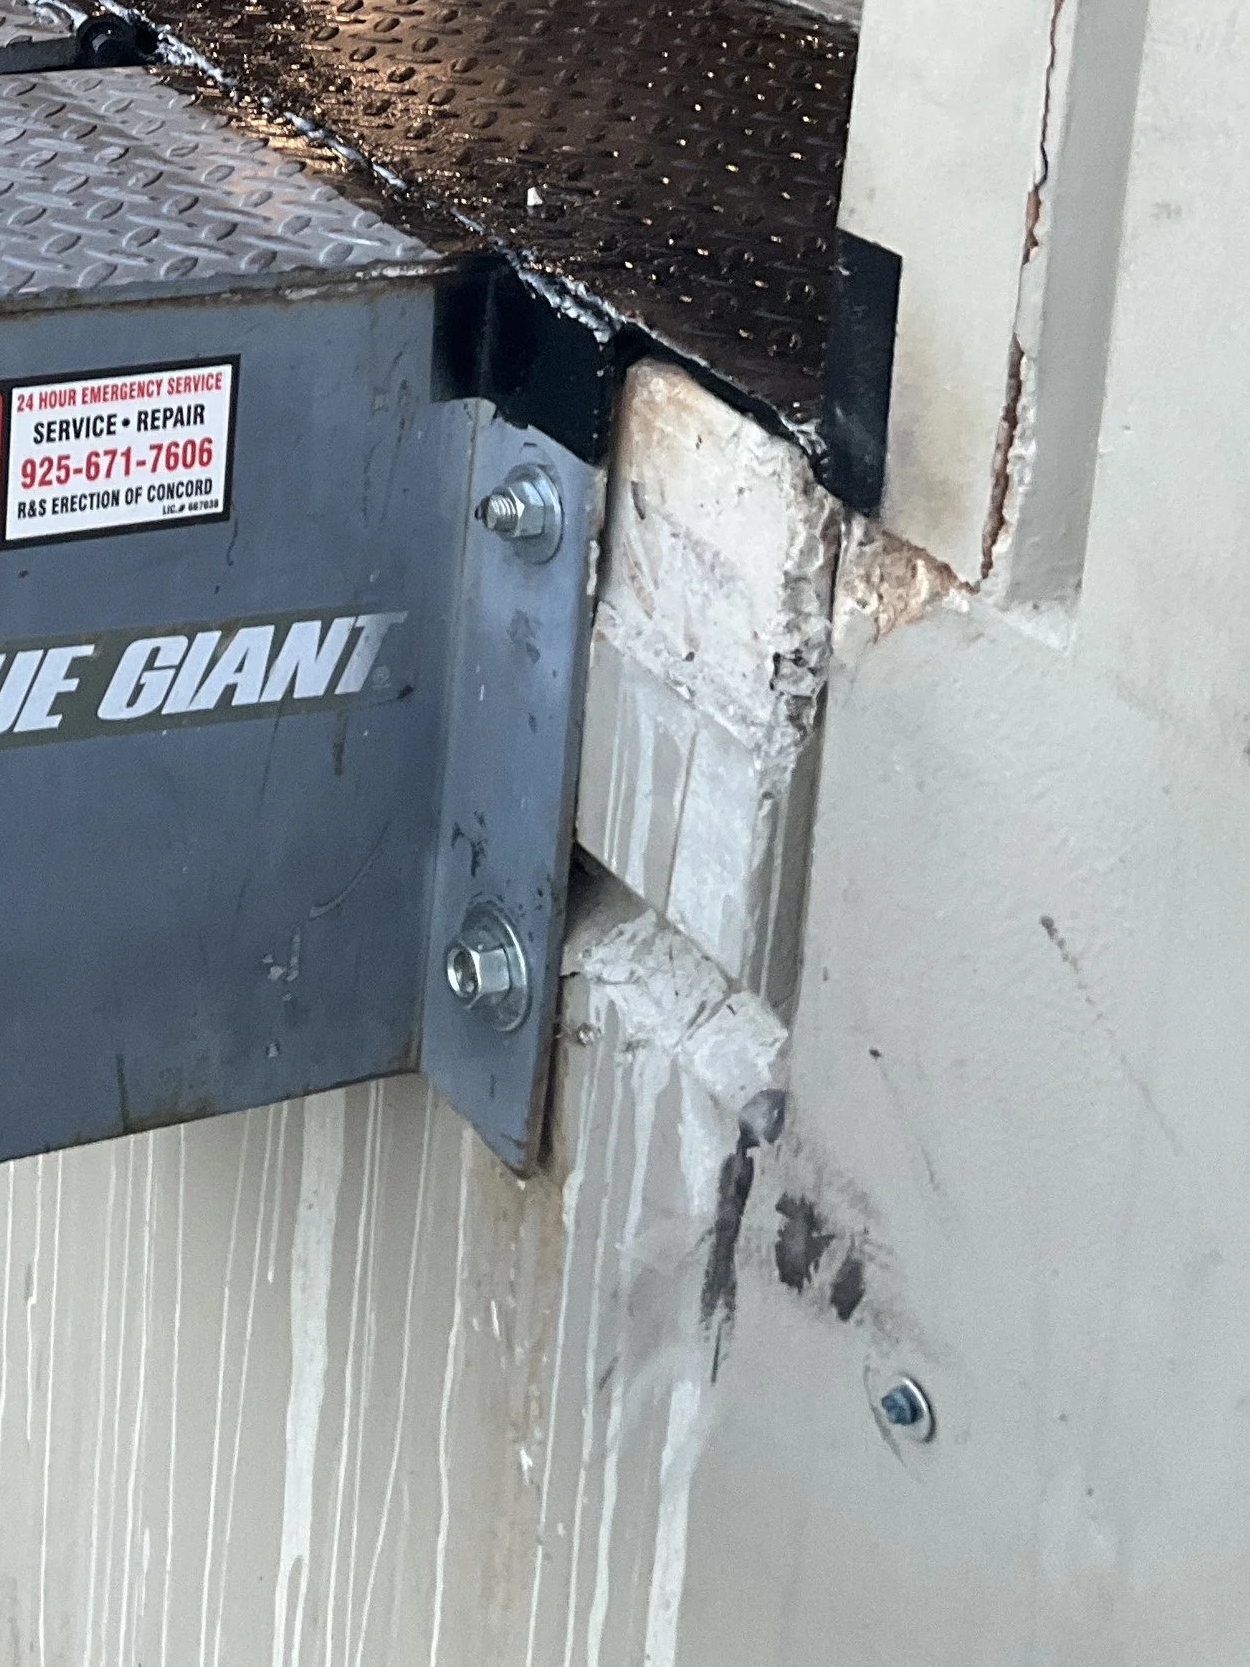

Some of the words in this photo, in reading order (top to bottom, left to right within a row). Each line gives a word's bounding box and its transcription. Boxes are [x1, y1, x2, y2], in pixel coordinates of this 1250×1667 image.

[17, 393, 33, 413] 24
[39, 389, 76, 410] HOUR
[82, 379, 162, 405] EMERGENCY
[167, 372, 223, 395] SERVICE
[33, 413, 117, 444] SERVICE
[137, 403, 205, 432] REPAIR
[21, 437, 213, 489] 925-671-7606
[17, 499, 47, 519] R&S
[52, 490, 120, 515] ERECTION
[125, 487, 142, 505] OF
[147, 478, 213, 502] CONCORD
[97, 611, 408, 721] GIANT
